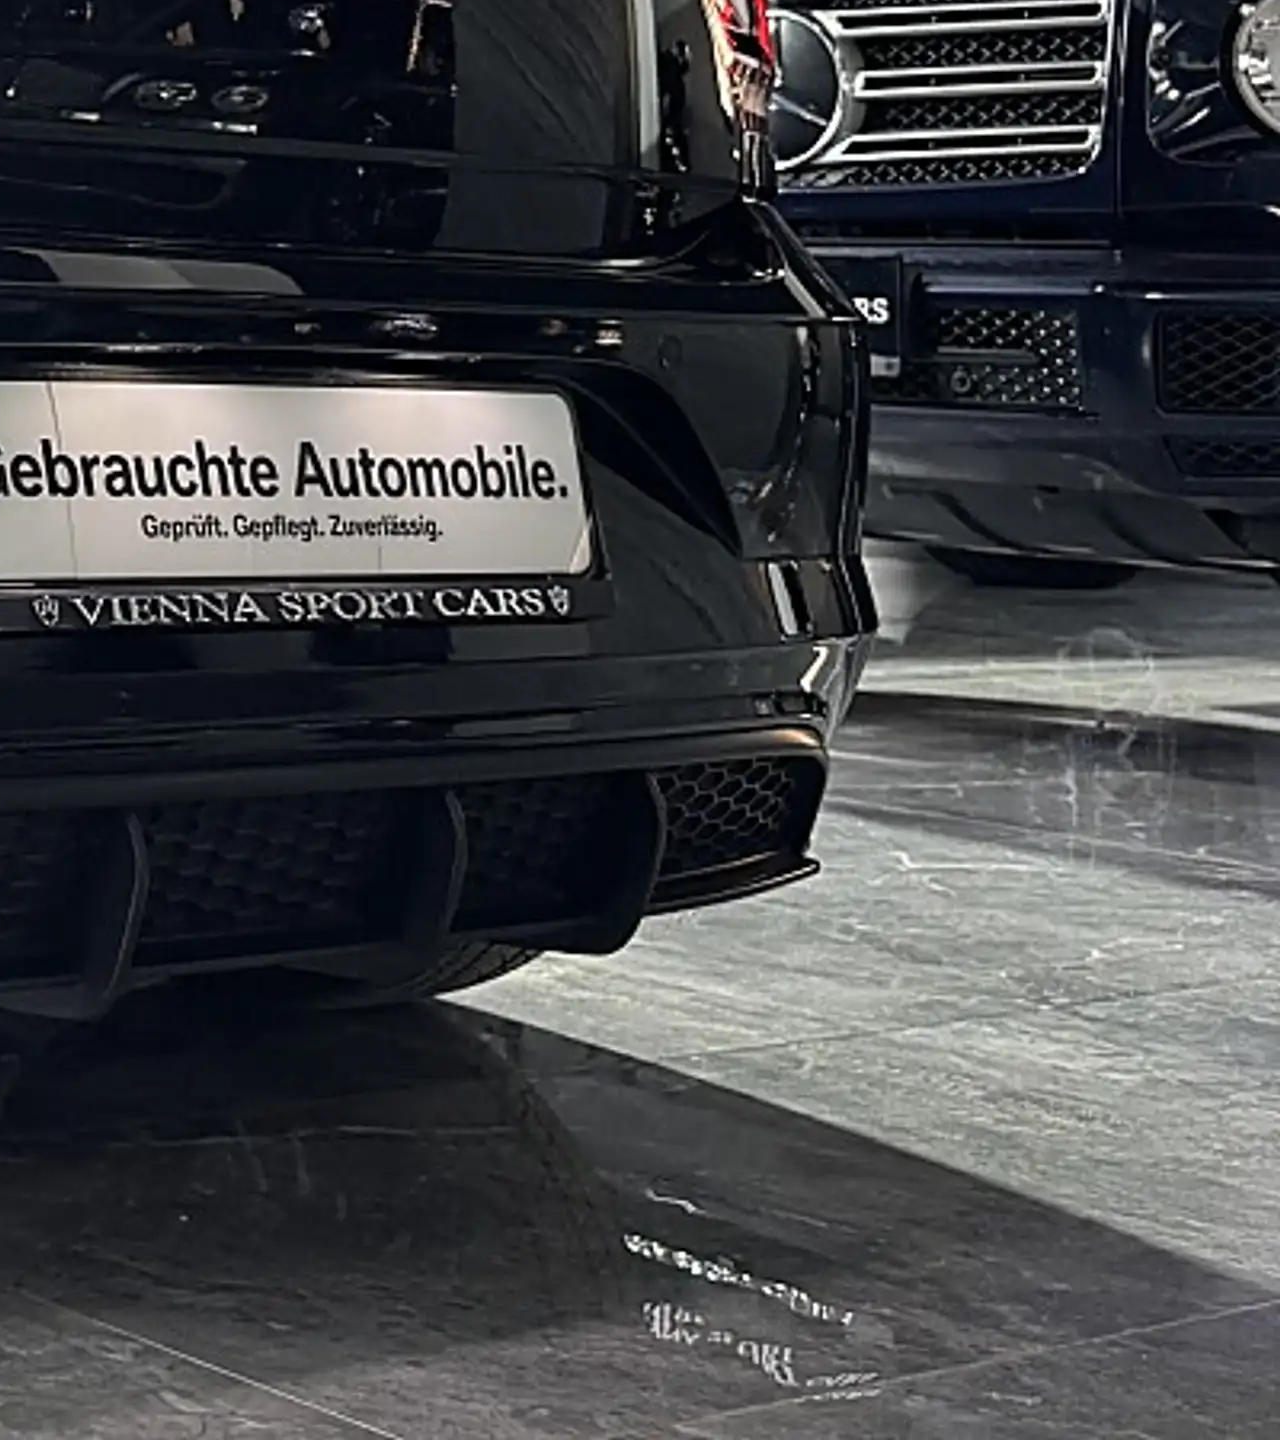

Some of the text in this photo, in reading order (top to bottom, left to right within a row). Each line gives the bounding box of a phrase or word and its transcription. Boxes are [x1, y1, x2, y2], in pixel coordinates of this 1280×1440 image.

[294, 440, 569, 499] Automobile.
[141, 513, 444, 542] Geprüft. Gepflegt. Zuverlässig.
[69, 587, 546, 627] VIENNA SPORT CARS
